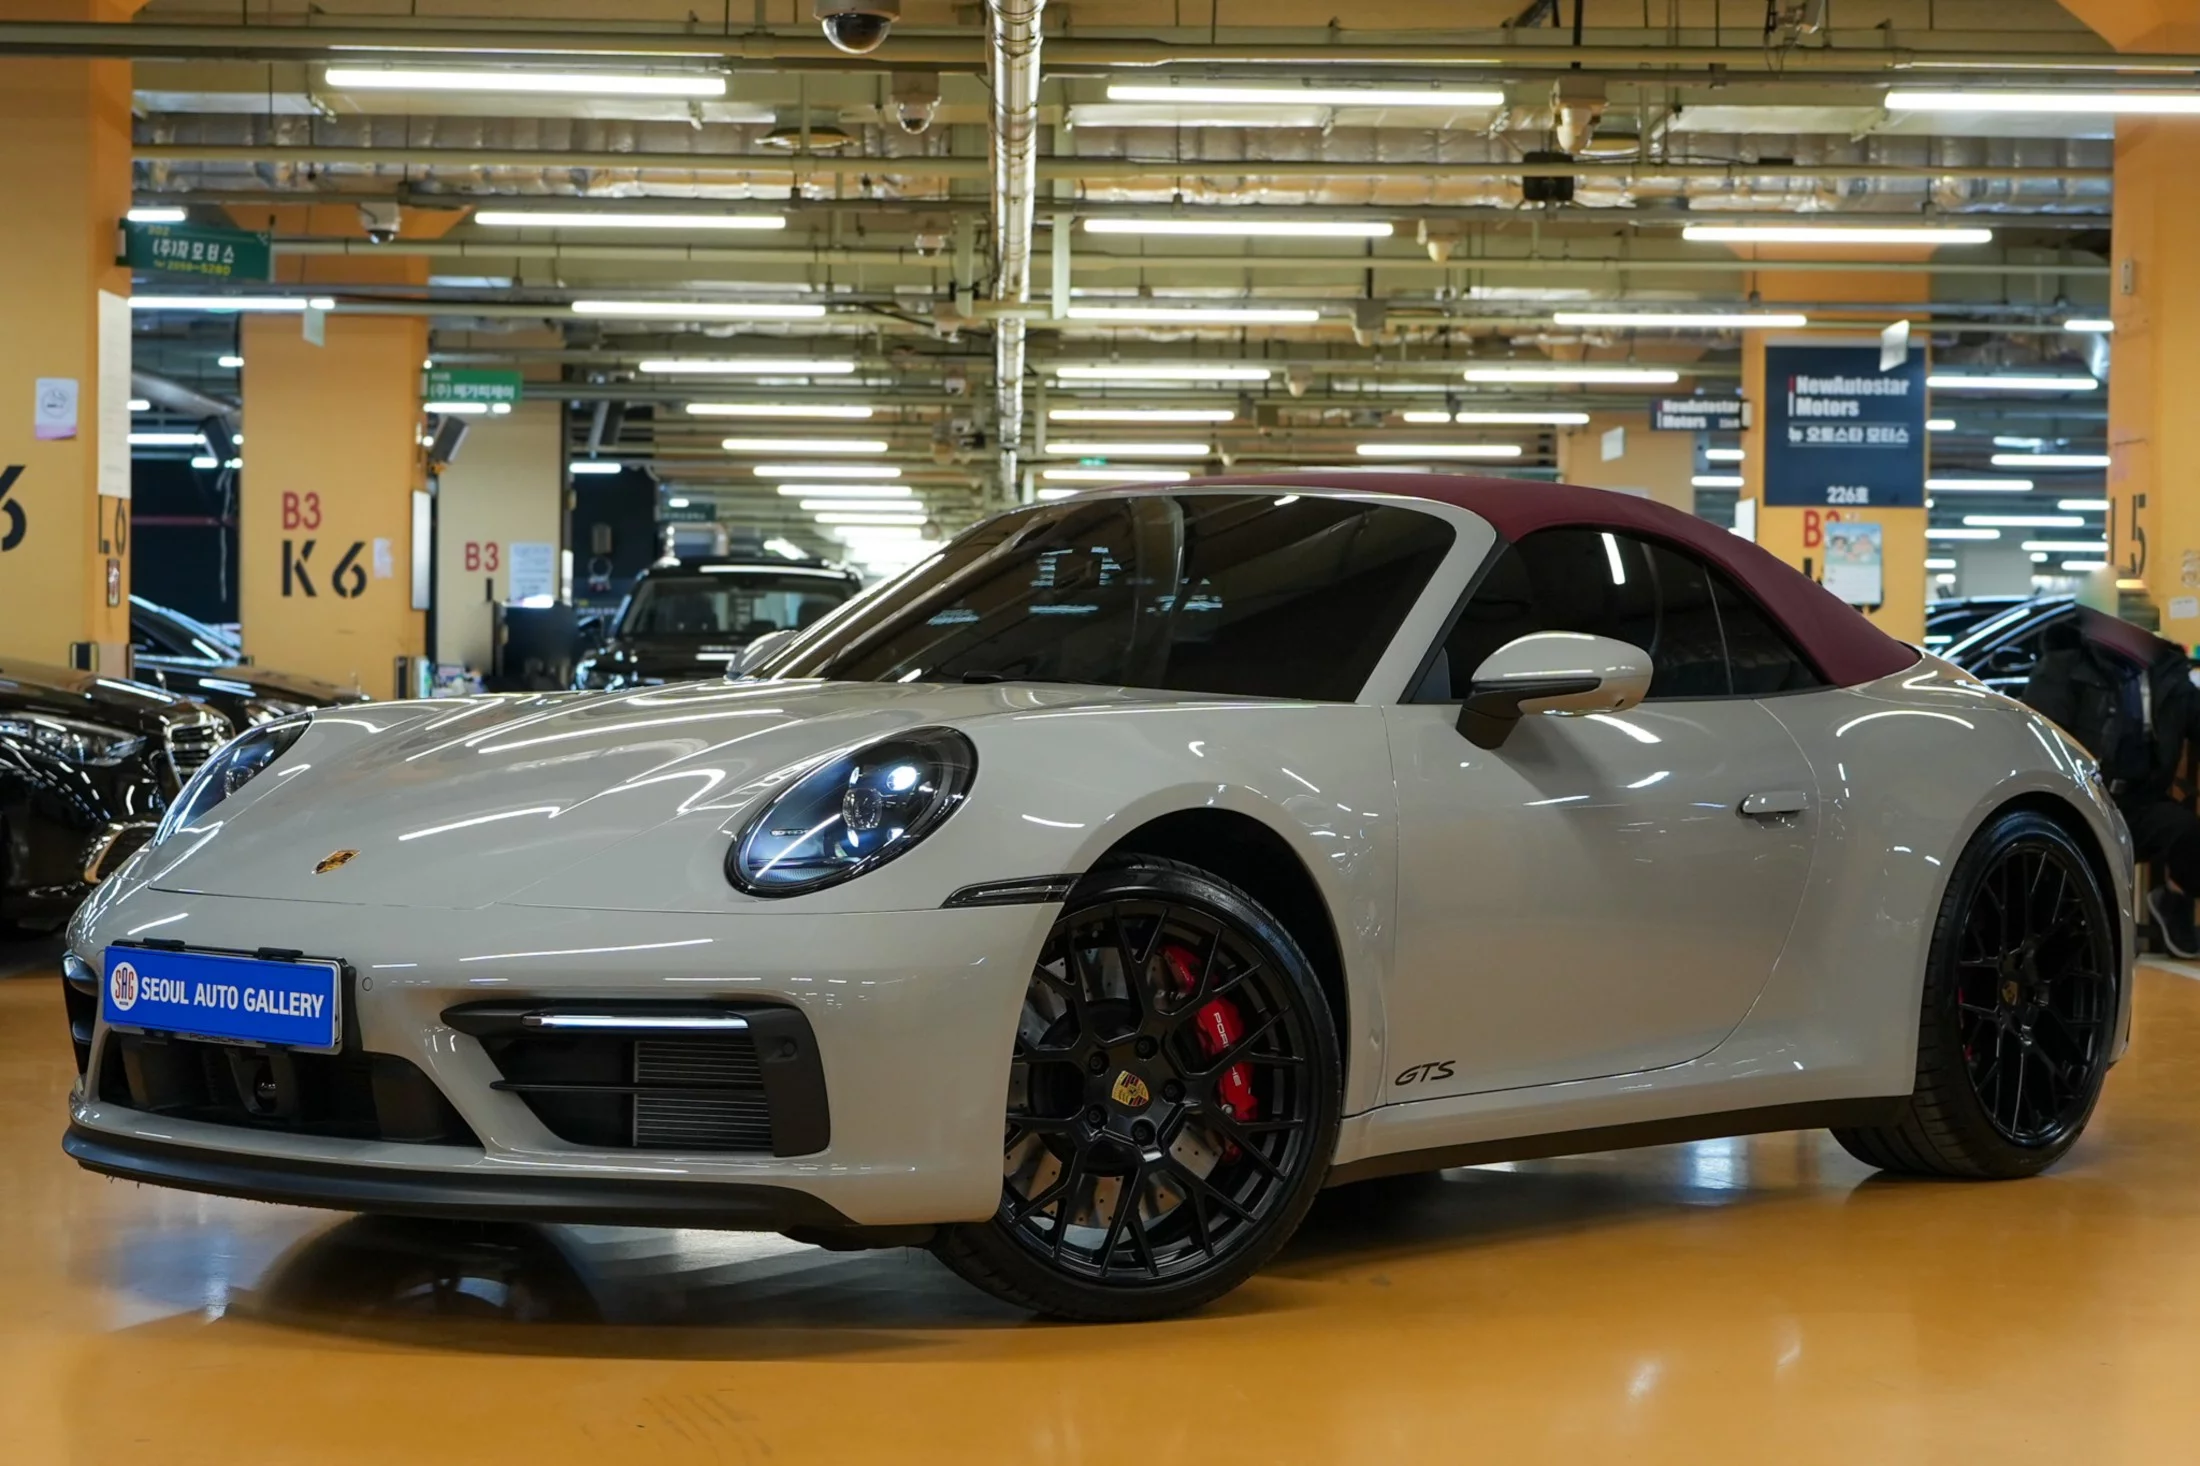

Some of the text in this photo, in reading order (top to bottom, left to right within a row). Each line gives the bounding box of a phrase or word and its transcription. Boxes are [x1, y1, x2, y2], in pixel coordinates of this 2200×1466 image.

[1796, 375, 1909, 396] NewAutostar
[1796, 398, 1860, 417] Motors
[1788, 426, 1909, 443] 뉴 오토스타 모터스
[1827, 486, 1870, 504] 226호
[282, 491, 321, 530] B3
[465, 541, 499, 572] B3
[115, 967, 134, 1000] SAG
[141, 976, 325, 1018] SEOUL AUTO GALLERY
[1395, 1060, 1456, 1086] GTS
